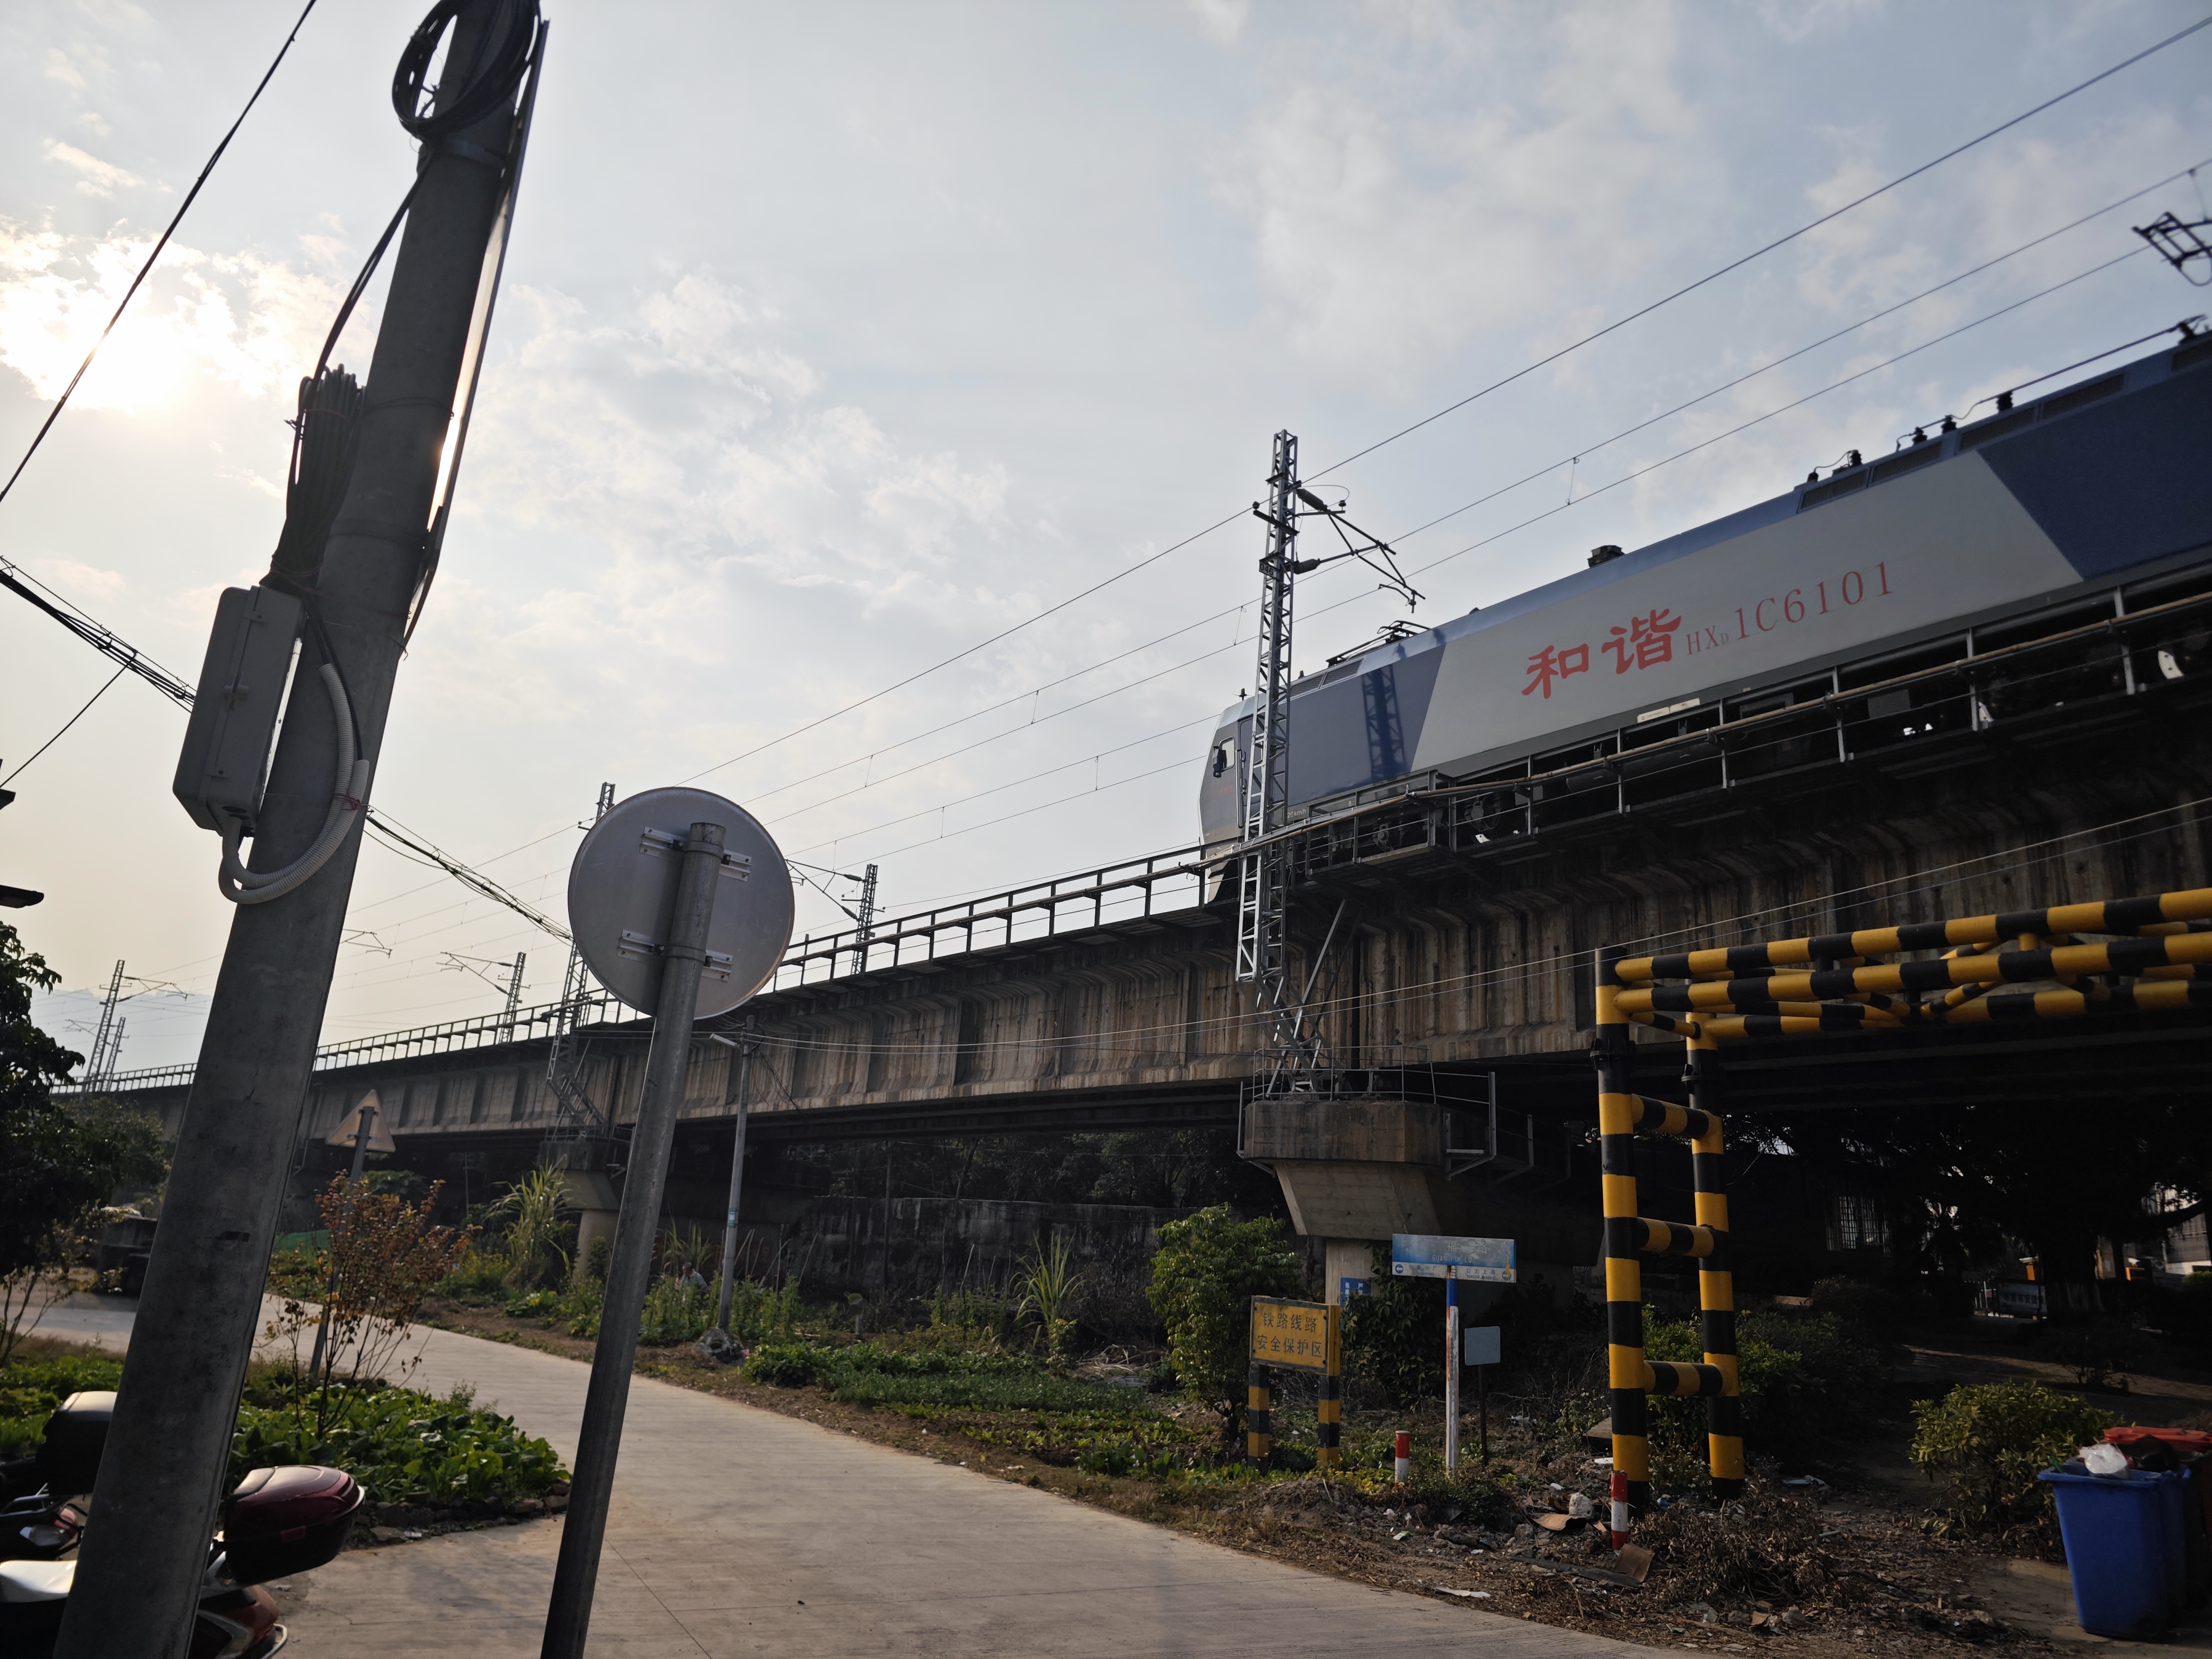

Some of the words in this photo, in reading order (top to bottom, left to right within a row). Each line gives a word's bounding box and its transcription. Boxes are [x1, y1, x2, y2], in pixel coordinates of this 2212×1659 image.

[1521, 608, 1682, 699] 和谐
[1294, 808, 1306, 817] km/h
[1263, 1311, 1317, 1333] 铁路线路
[1257, 1334, 1323, 1358] 安全保护区
